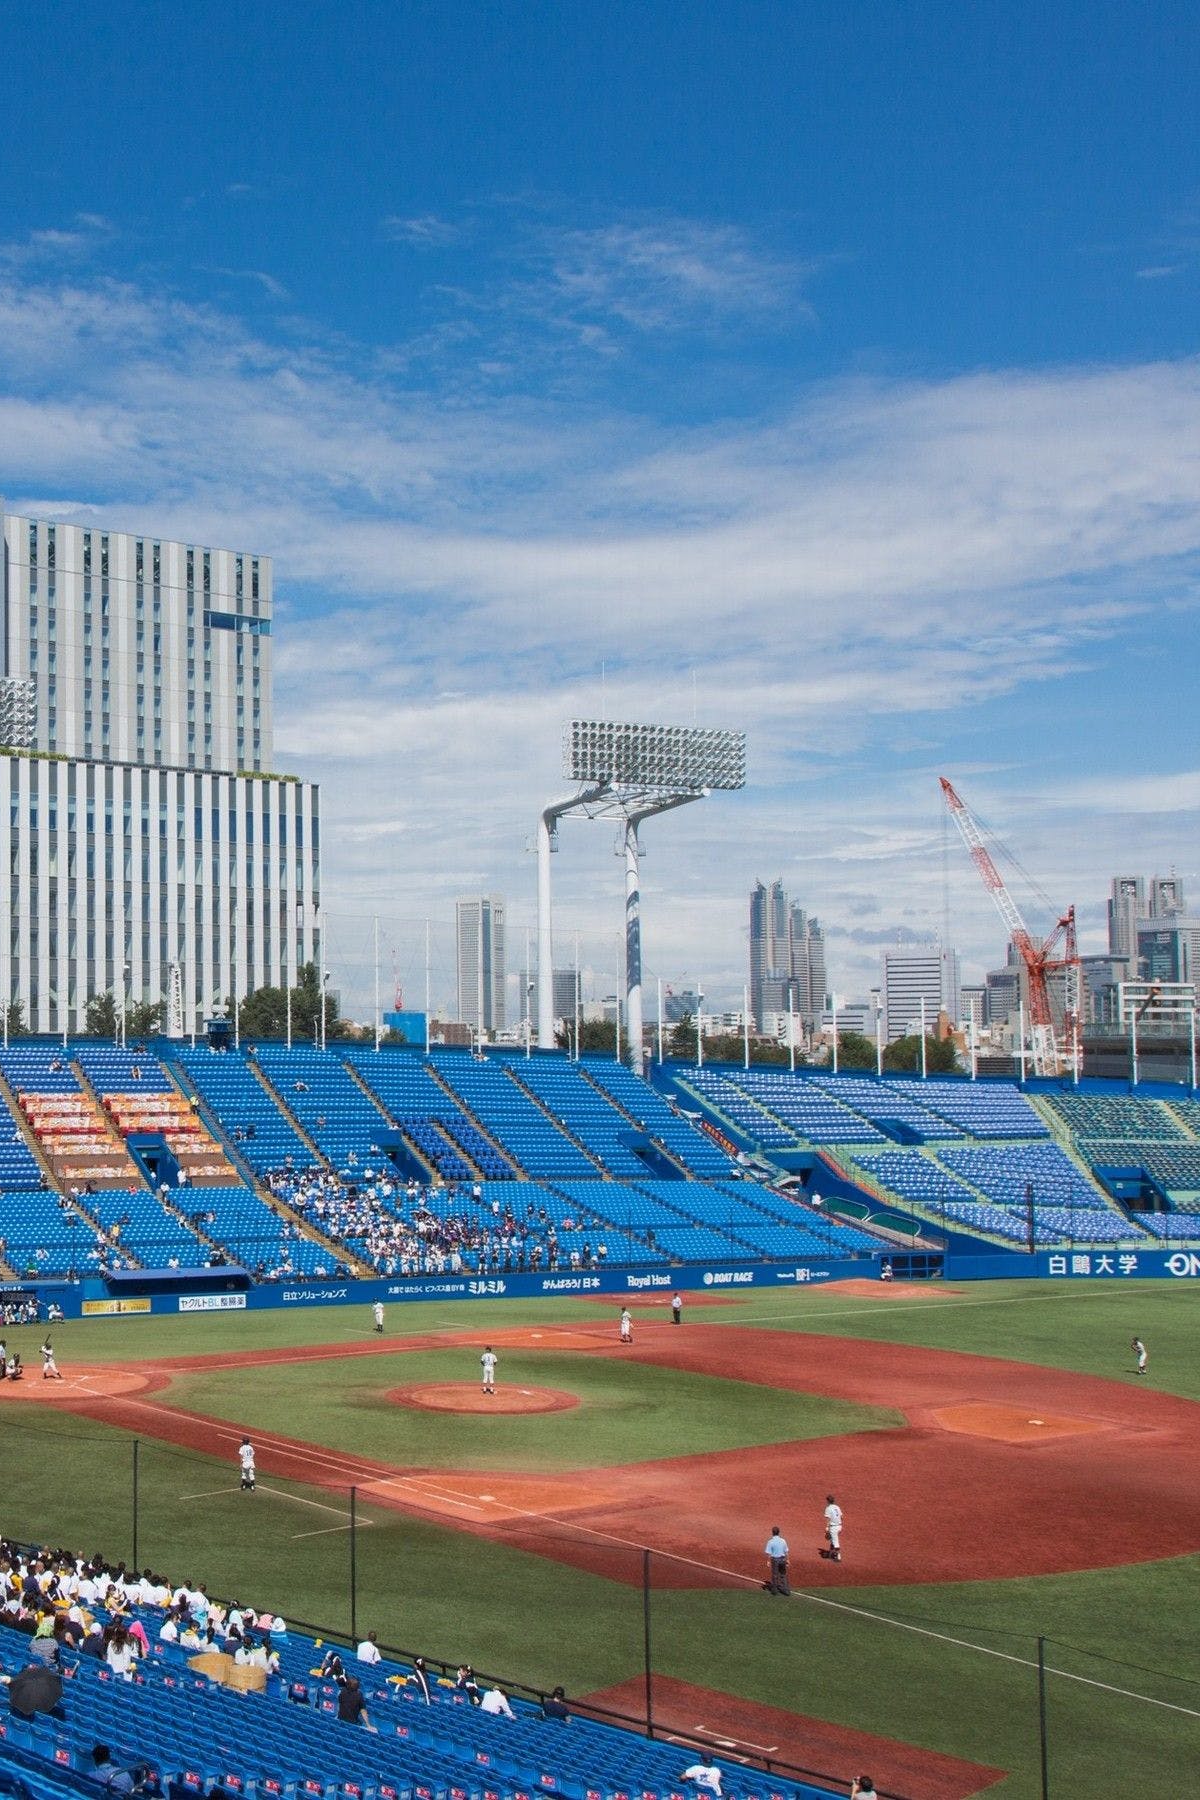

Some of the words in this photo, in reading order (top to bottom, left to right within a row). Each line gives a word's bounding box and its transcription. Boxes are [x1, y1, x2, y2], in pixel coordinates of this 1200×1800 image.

[628, 1275, 651, 1289] Royal
[653, 1275, 671, 1285] Host
[713, 1273, 733, 1283] BOAT
[734, 1272, 753, 1282] RACE
[469, 1280, 506, 1295] ミルミル
[283, 1289, 347, 1301] 日立ソリューションズ
